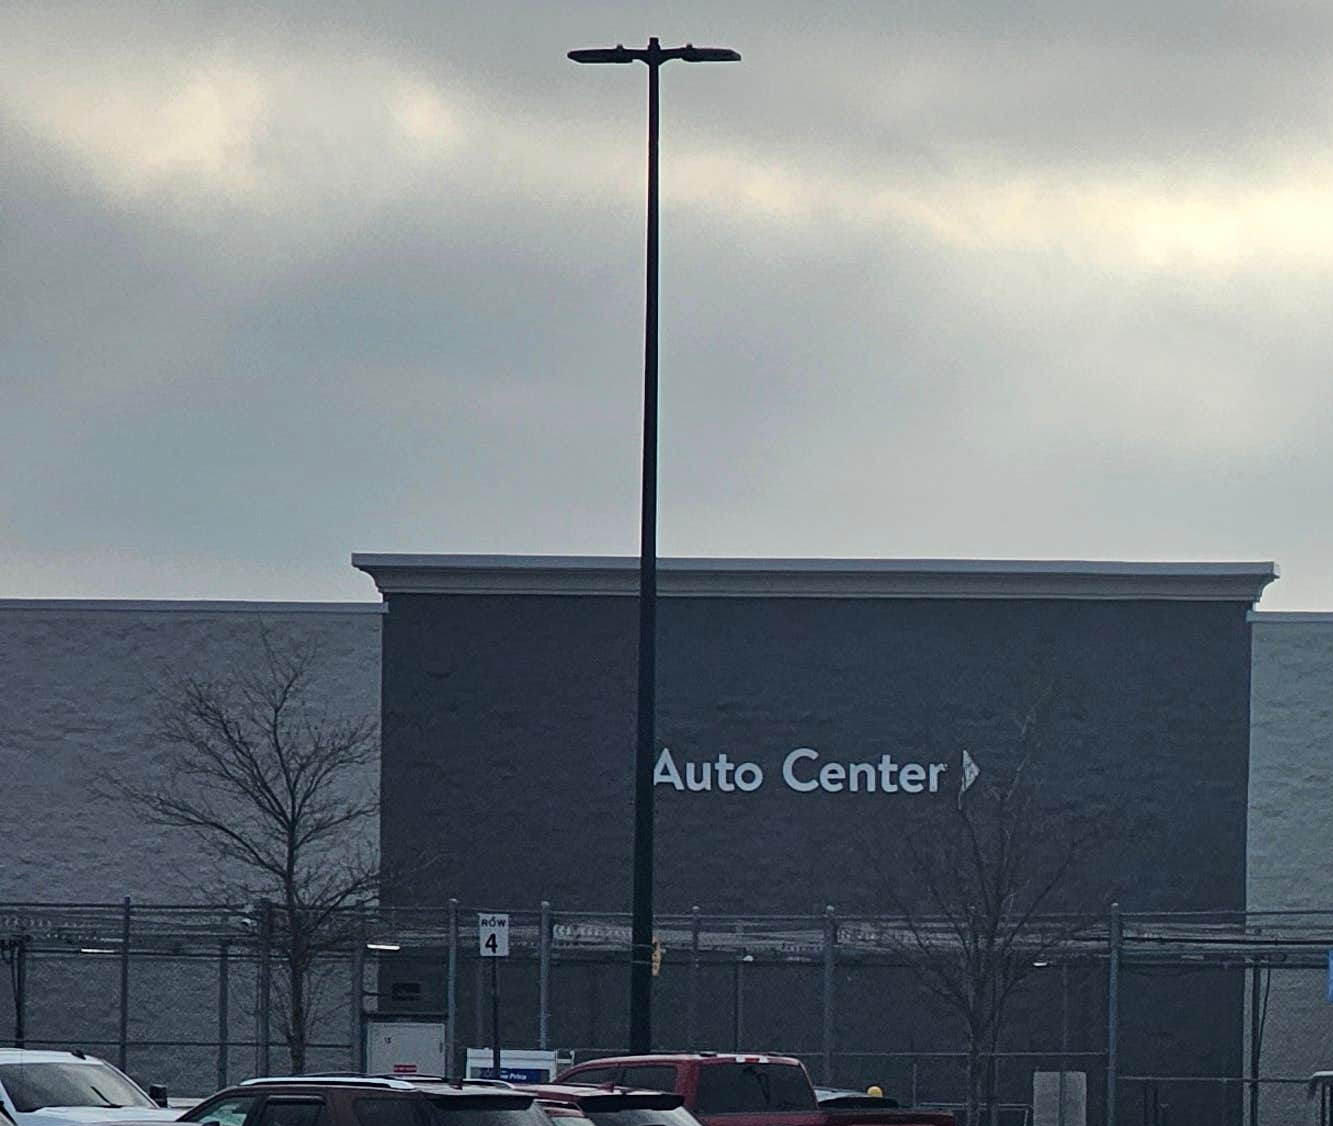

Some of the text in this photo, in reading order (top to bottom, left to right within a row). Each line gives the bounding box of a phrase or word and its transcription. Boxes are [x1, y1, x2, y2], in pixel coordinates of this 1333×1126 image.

[652, 747, 948, 793] Auto Center
[481, 918, 506, 928] ROW
[485, 932, 499, 954] 4
